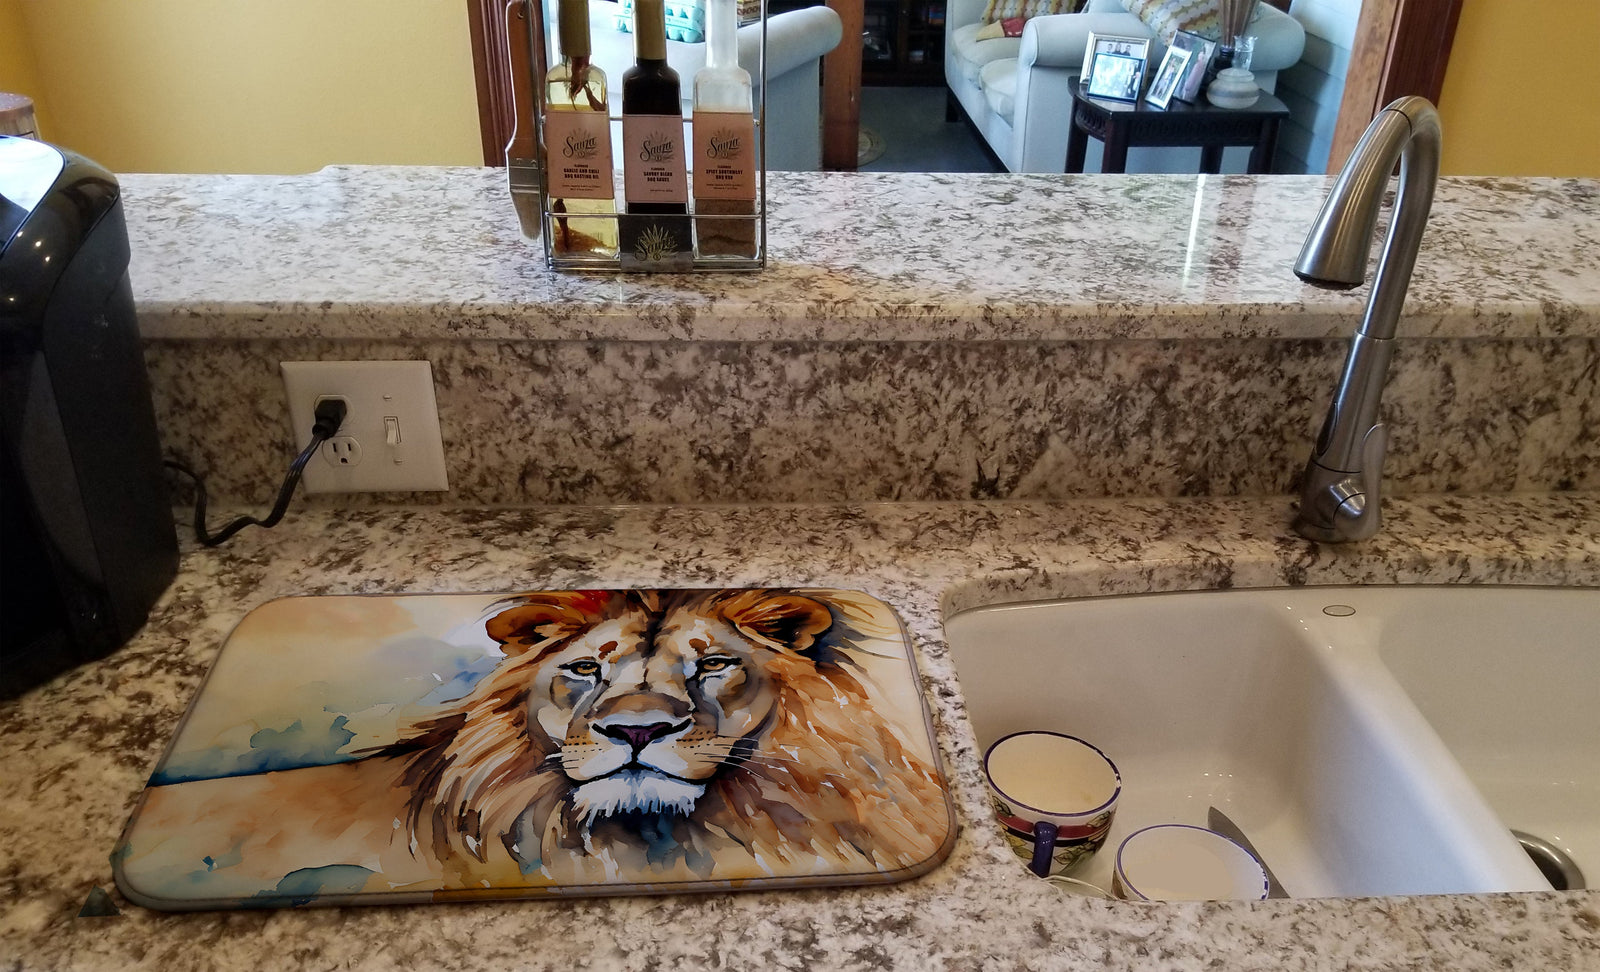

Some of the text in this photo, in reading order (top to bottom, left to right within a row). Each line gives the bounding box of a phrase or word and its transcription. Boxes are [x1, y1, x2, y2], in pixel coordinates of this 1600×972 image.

[563, 136, 598, 158] Sauza
[640, 140, 673, 161] Sauza
[707, 137, 741, 158] Sauza
